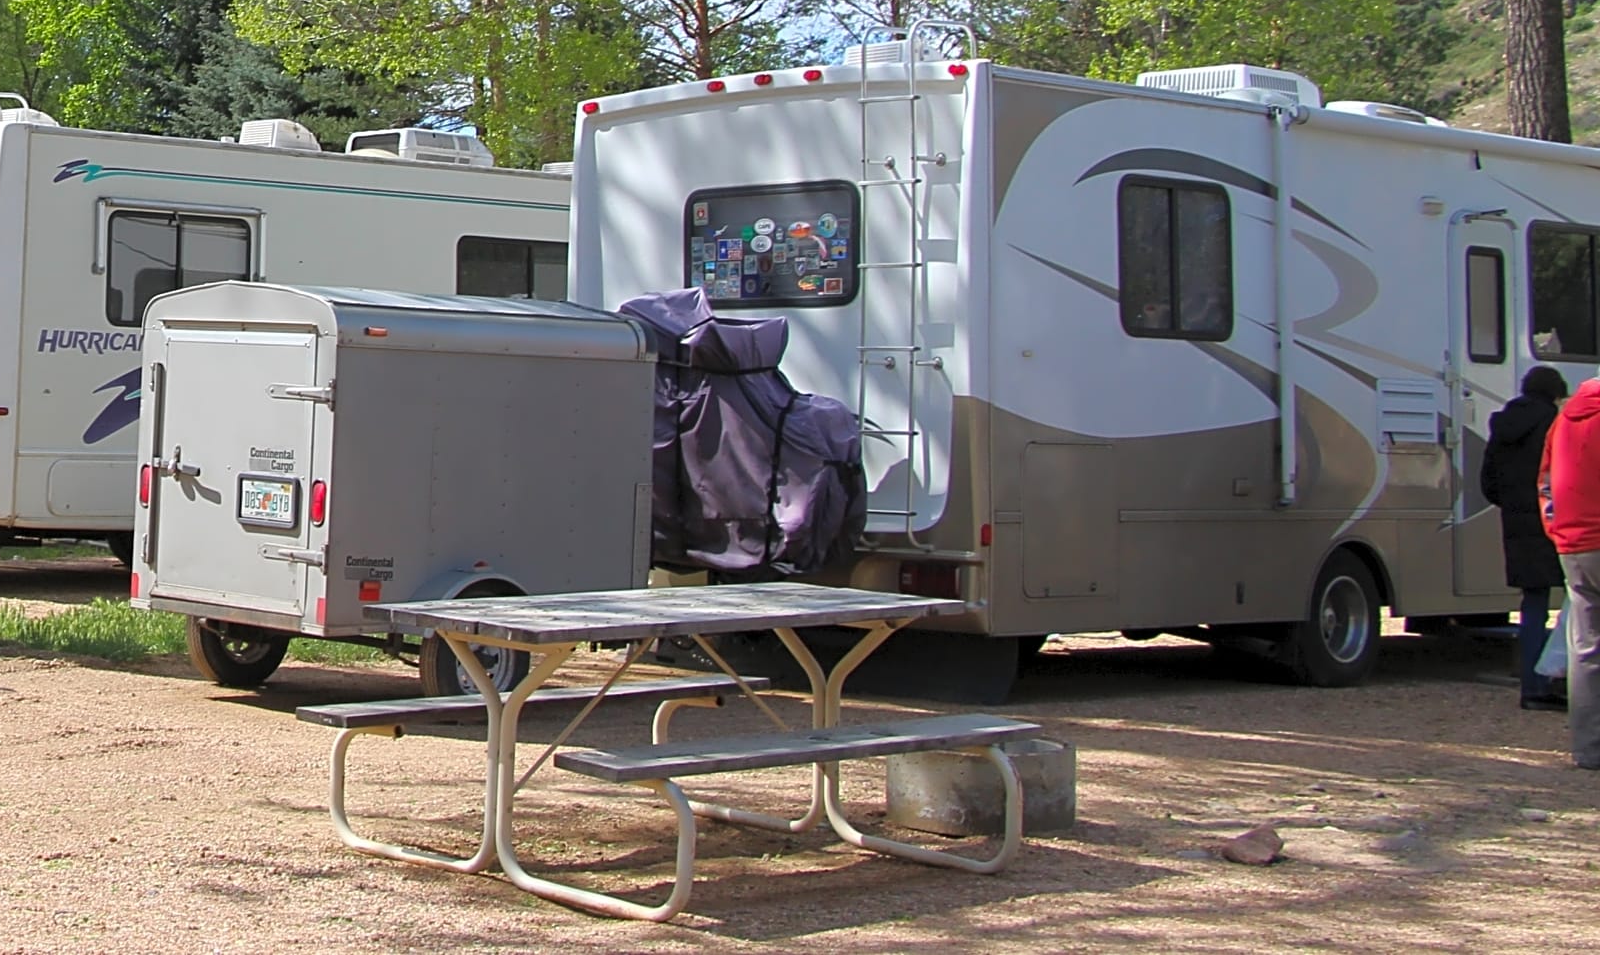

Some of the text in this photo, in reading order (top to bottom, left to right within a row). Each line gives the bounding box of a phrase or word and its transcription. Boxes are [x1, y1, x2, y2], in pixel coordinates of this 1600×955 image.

[37, 329, 143, 355] HURRICA
[250, 447, 294, 459] Continental
[271, 459, 294, 473] Cargo
[346, 556, 394, 567] Continental
[369, 568, 393, 581] Cargo
